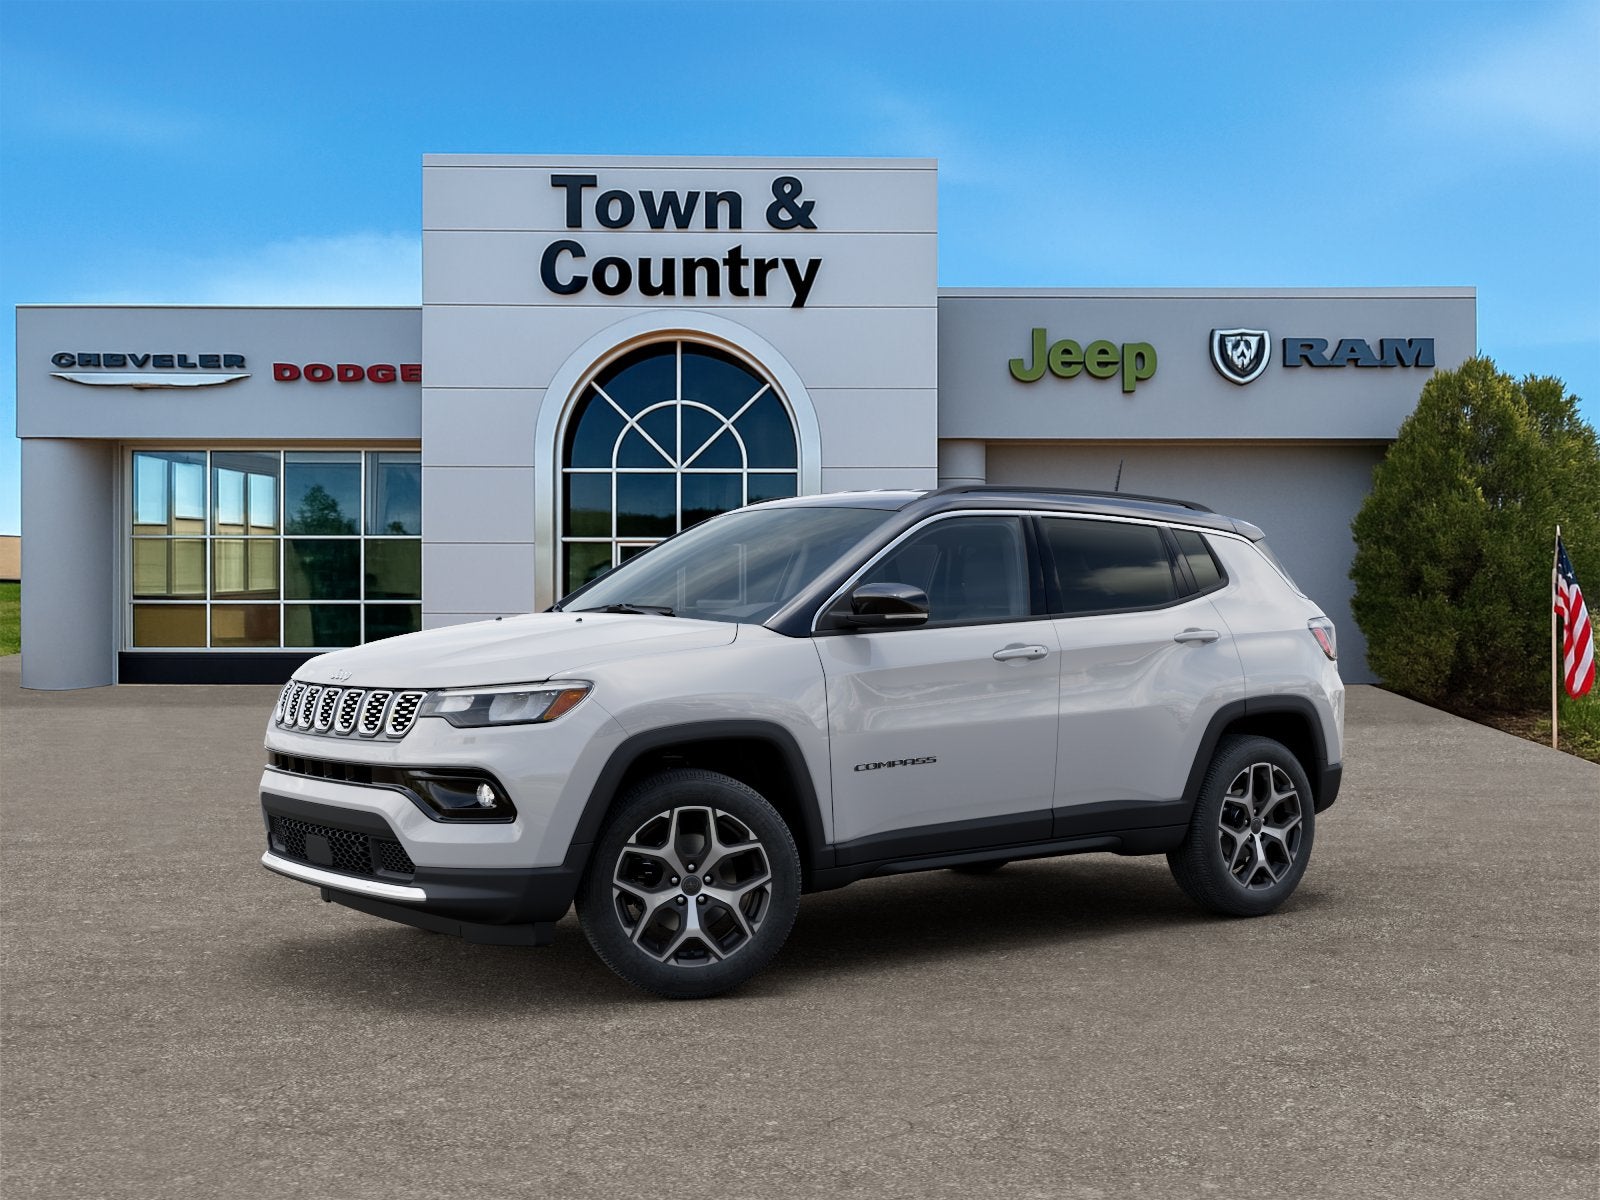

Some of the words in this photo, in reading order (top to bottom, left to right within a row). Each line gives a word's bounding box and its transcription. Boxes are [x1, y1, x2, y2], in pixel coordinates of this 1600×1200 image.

[550, 174, 742, 230] Town
[765, 176, 818, 230] &
[540, 239, 822, 308] Country
[272, 362, 422, 384] DODGE
[1008, 327, 1157, 393] Jeep
[1282, 337, 1435, 368] RAM
[853, 756, 937, 772] COMPASS
